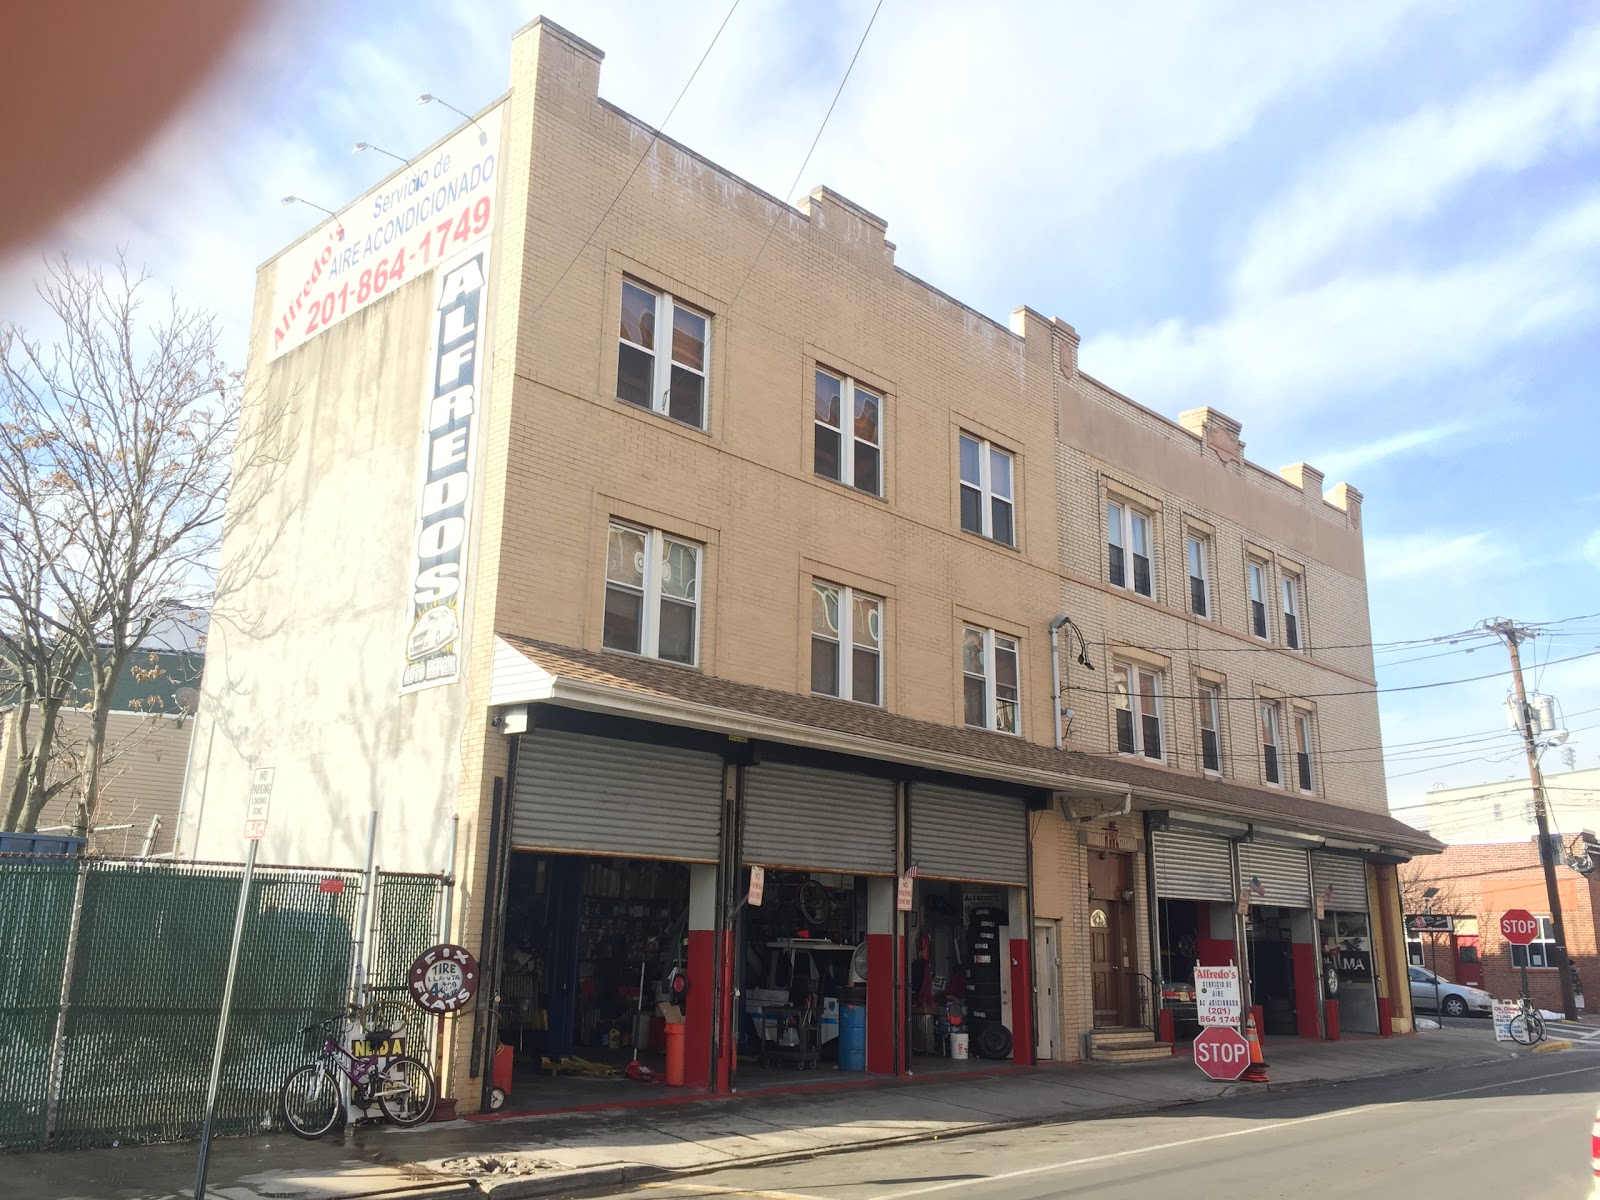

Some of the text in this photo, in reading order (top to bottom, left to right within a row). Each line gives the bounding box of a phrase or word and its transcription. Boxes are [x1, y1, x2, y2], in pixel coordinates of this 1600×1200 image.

[373, 152, 451, 219] Servicio de
[328, 154, 495, 281] AIRE ACONDICIONADO
[304, 195, 491, 336] 201-864-1749
[273, 222, 345, 351] Alfredo's
[414, 252, 485, 605] ALFREDOS
[259, 770, 268, 781] NO
[251, 783, 272, 795] PARKING
[1502, 919, 1536, 934] STOP
[424, 947, 469, 965] FIX
[432, 962, 457, 975] TIRE
[1196, 969, 1237, 980] Alfredo's
[413, 980, 471, 1011] FLATS
[1200, 1015, 1216, 1023] 864
[1208, 1007, 1231, 1015] (201)
[355, 1039, 402, 1057] NED A
[1198, 1042, 1246, 1063] STOP
